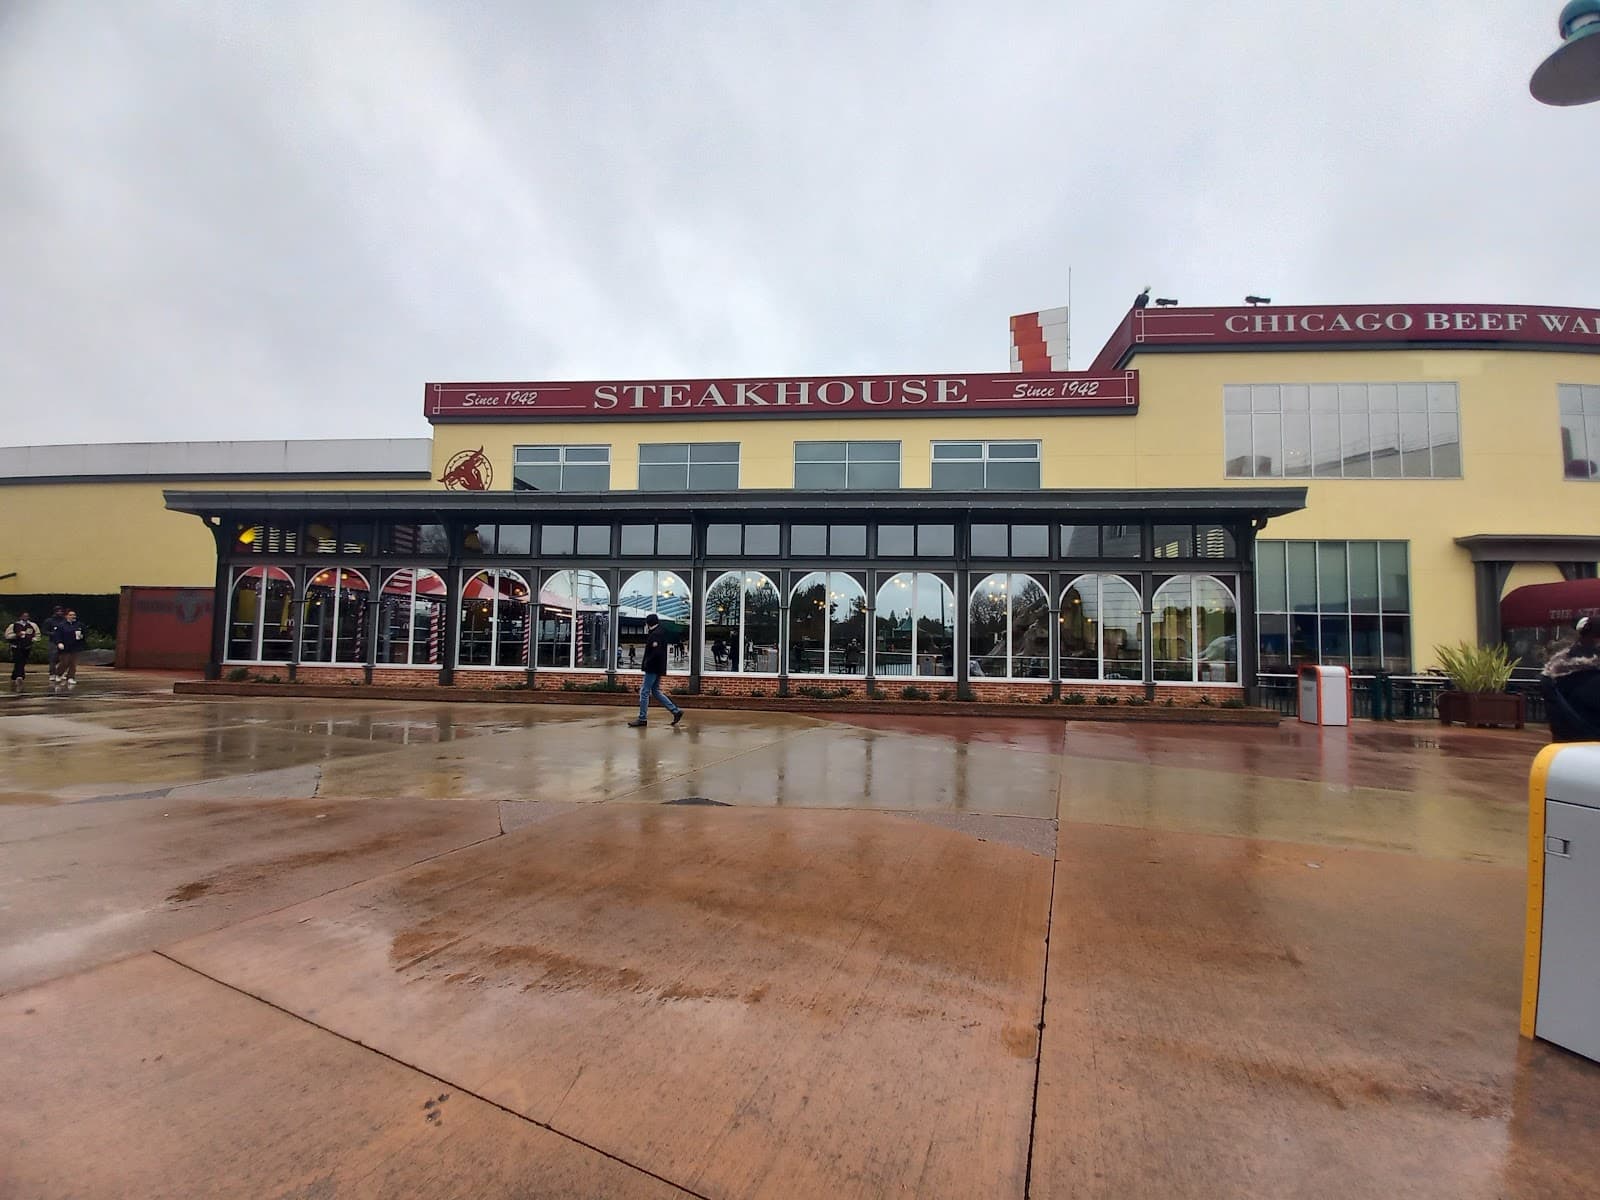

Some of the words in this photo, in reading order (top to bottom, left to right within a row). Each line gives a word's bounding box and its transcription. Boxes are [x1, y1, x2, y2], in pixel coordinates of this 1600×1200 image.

[1225, 312, 1413, 333] CHICAGO
[1424, 312, 1527, 331] BEEF
[462, 392, 500, 406] Since
[504, 391, 538, 405] 1942
[593, 378, 968, 410] STEAKHOUSE
[1013, 384, 1055, 399] Since
[1061, 381, 1099, 396] 1942
